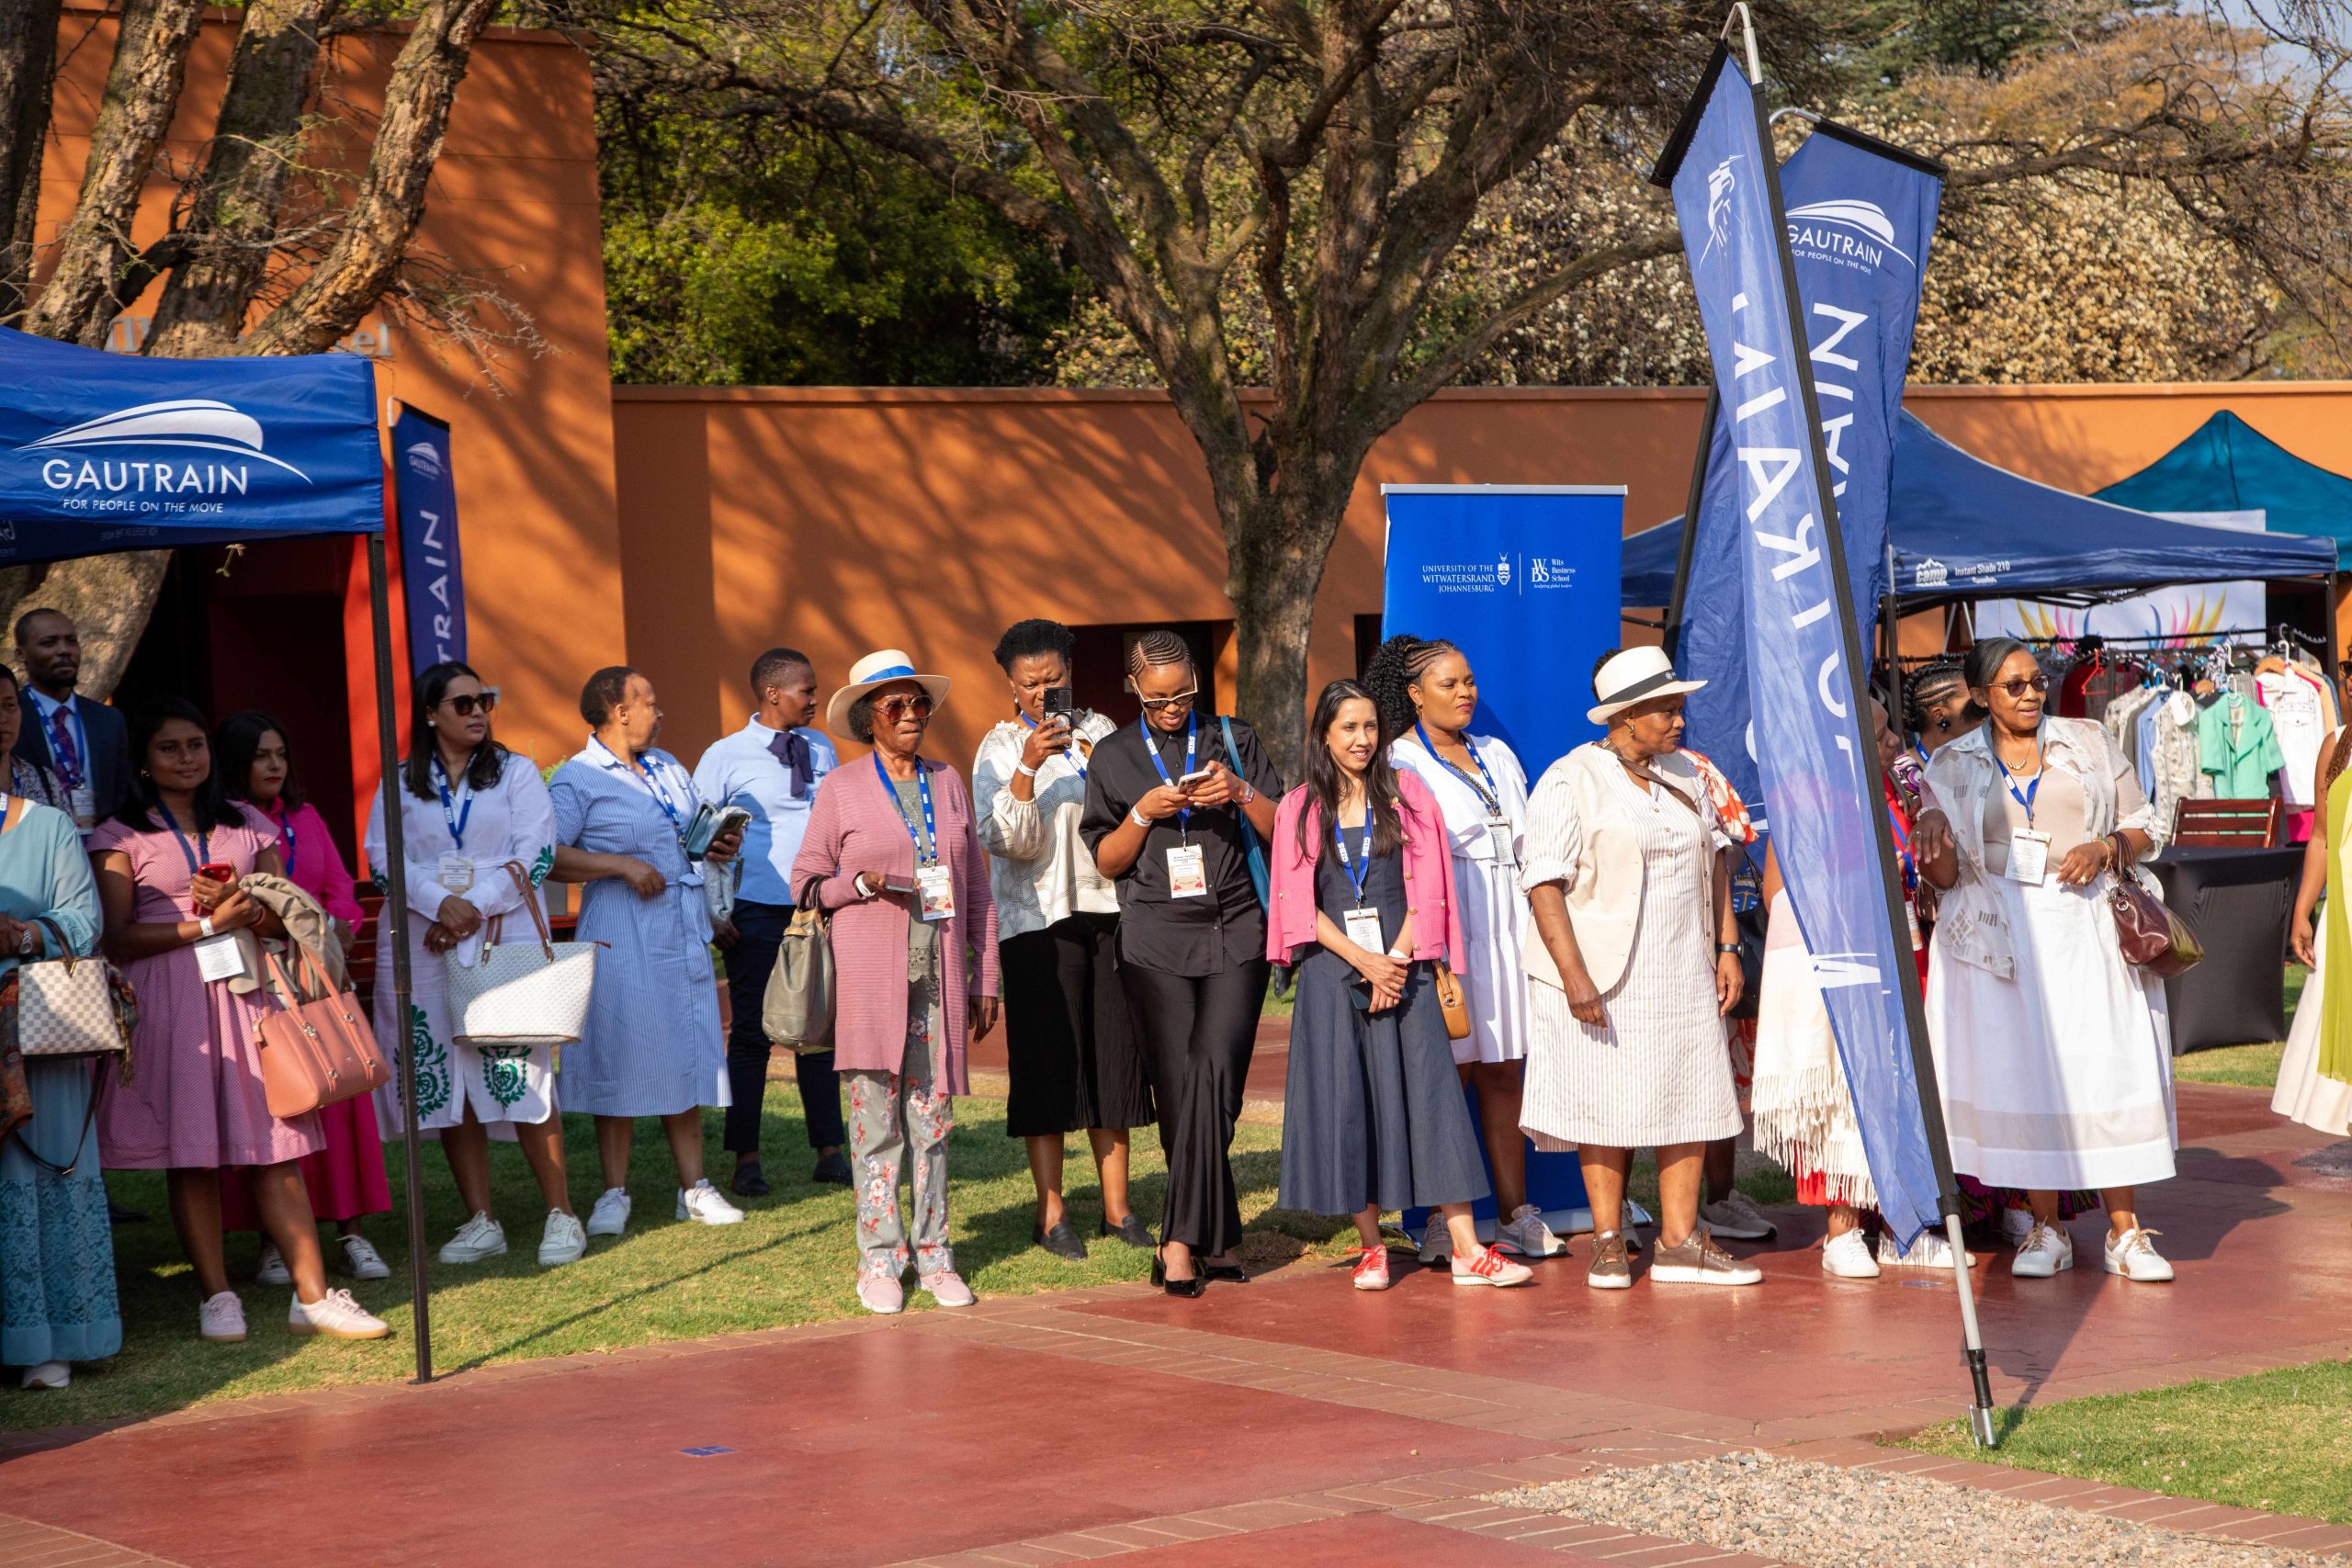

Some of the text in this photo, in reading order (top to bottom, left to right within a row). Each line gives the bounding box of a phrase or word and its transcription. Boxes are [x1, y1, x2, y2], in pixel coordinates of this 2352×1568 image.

[1788, 224, 1883, 268] GAUTRAIN
[1808, 252, 1832, 262] PEOPLE
[42, 458, 248, 496] GAUTRAIN
[62, 499, 224, 513] FOR PEOPLE ON THE MOVE
[1955, 561, 2010, 576] Instant Shade 210
[1439, 585, 1495, 594] JOHANNESBURG
